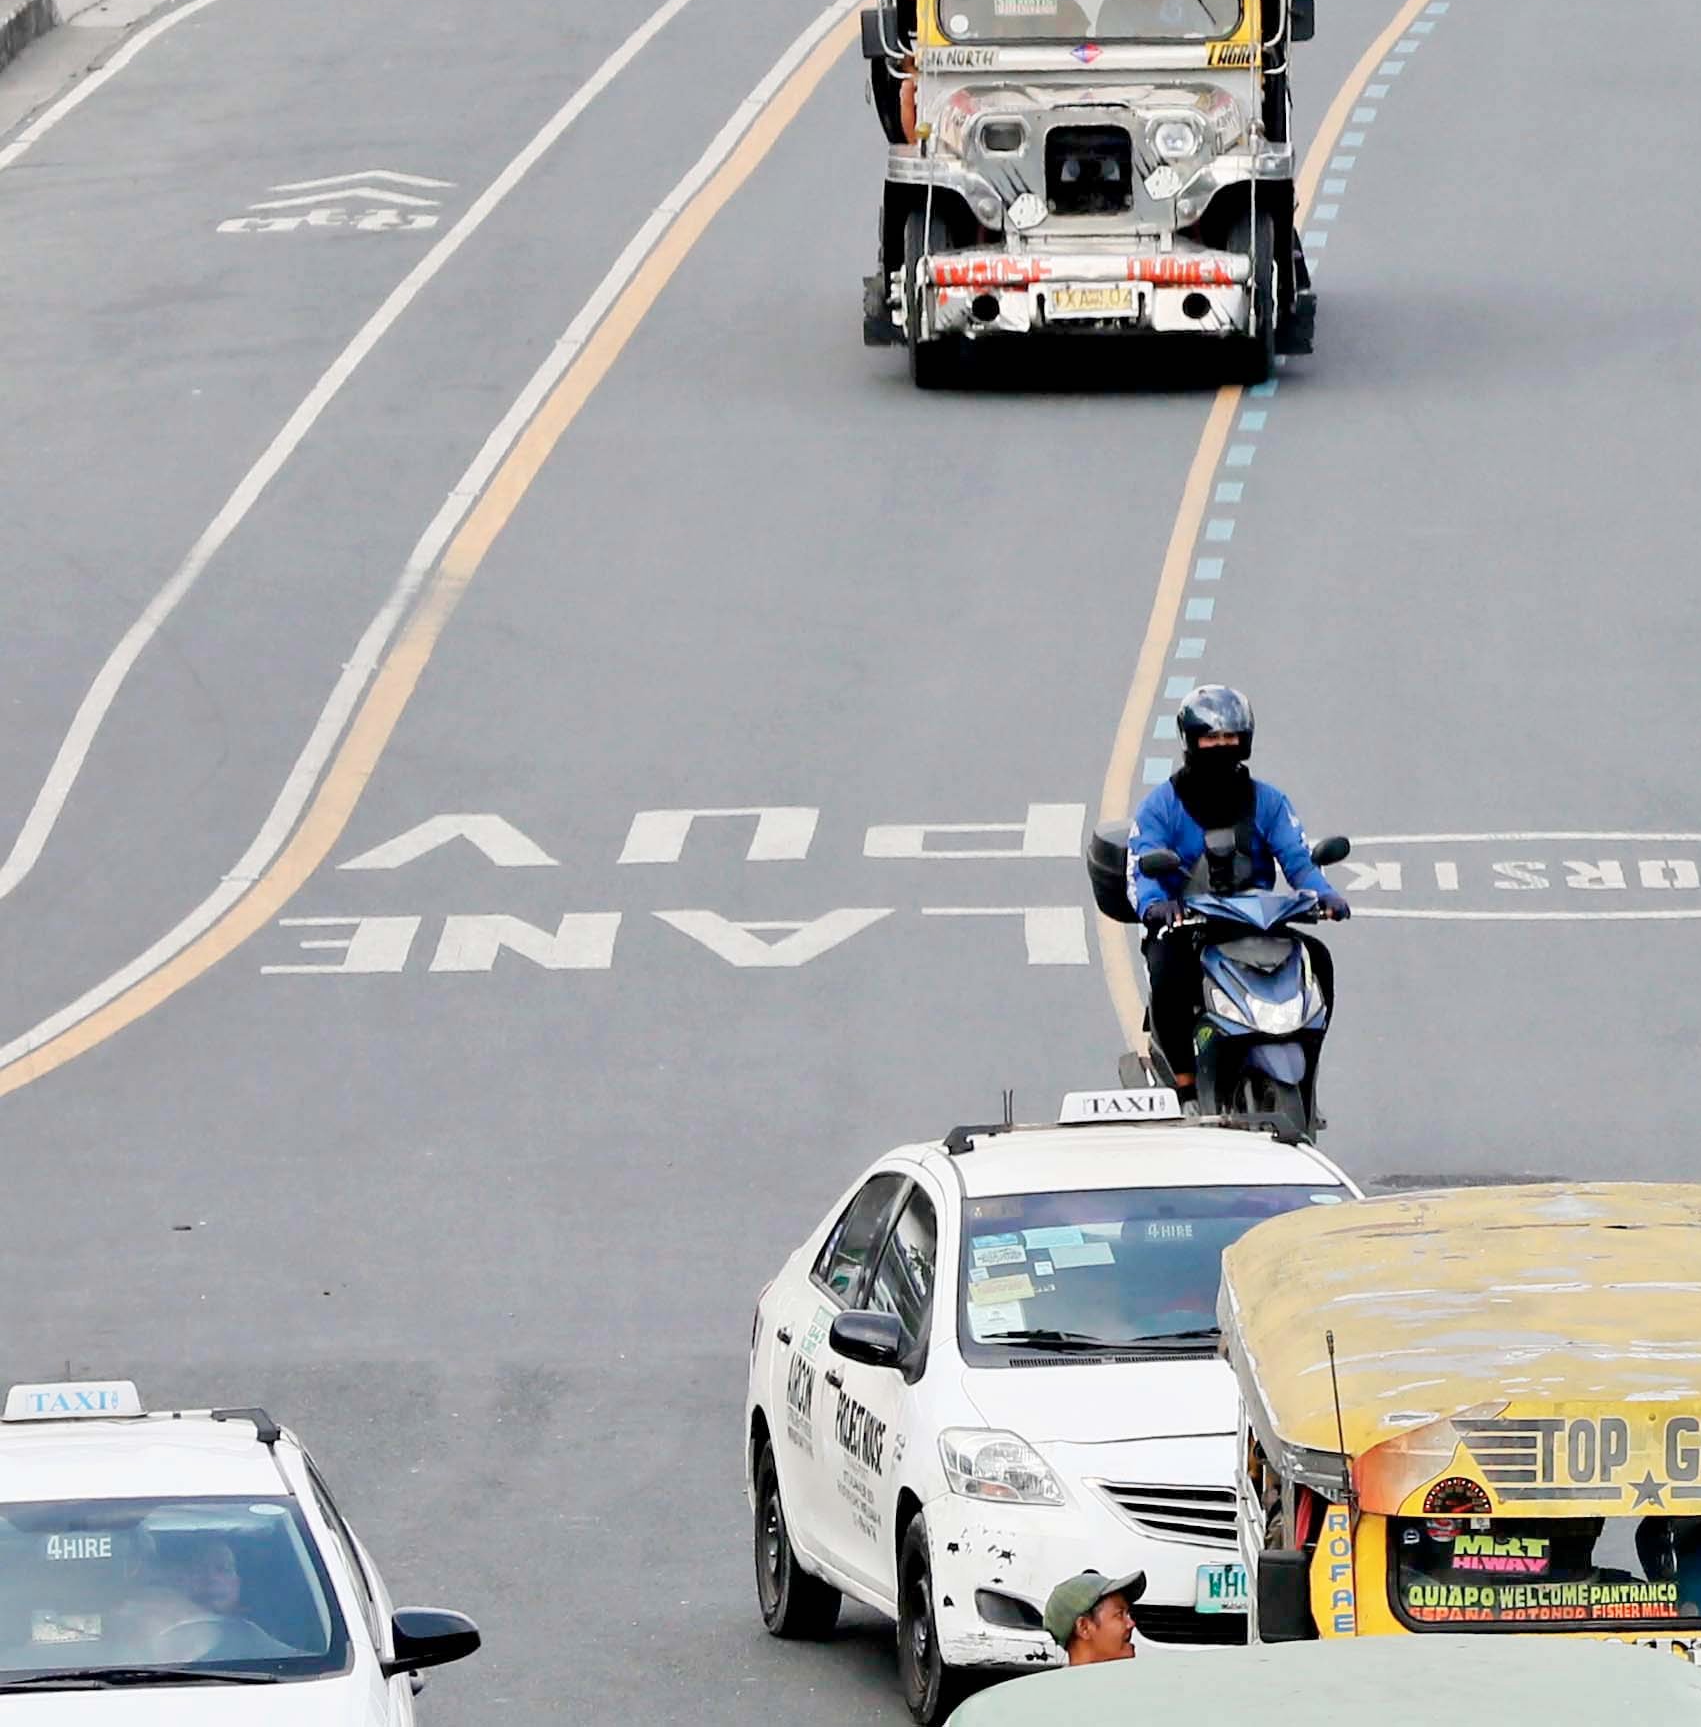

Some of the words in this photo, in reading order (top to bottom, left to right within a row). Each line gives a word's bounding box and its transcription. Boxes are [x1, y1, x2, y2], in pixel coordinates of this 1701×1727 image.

[946, 49, 994, 68] NORTH
[337, 803, 1086, 870] PUV
[261, 907, 1090, 974] LANE
[1087, 1096, 1155, 1114] TAXI
[30, 1391, 109, 1413] TAXI
[862, 1409, 887, 1477] HOUSE
[1540, 1416, 1628, 1483] TOP
[1454, 1534, 1550, 1558] MRT
[1409, 1585, 1496, 1607] QUIAPO
[1500, 1584, 1589, 1610] WELCOME
[1590, 1583, 1678, 1604] PANTRANCO
[1592, 1603, 1640, 1619] FISHER
[1642, 1602, 1679, 1619] MALL
